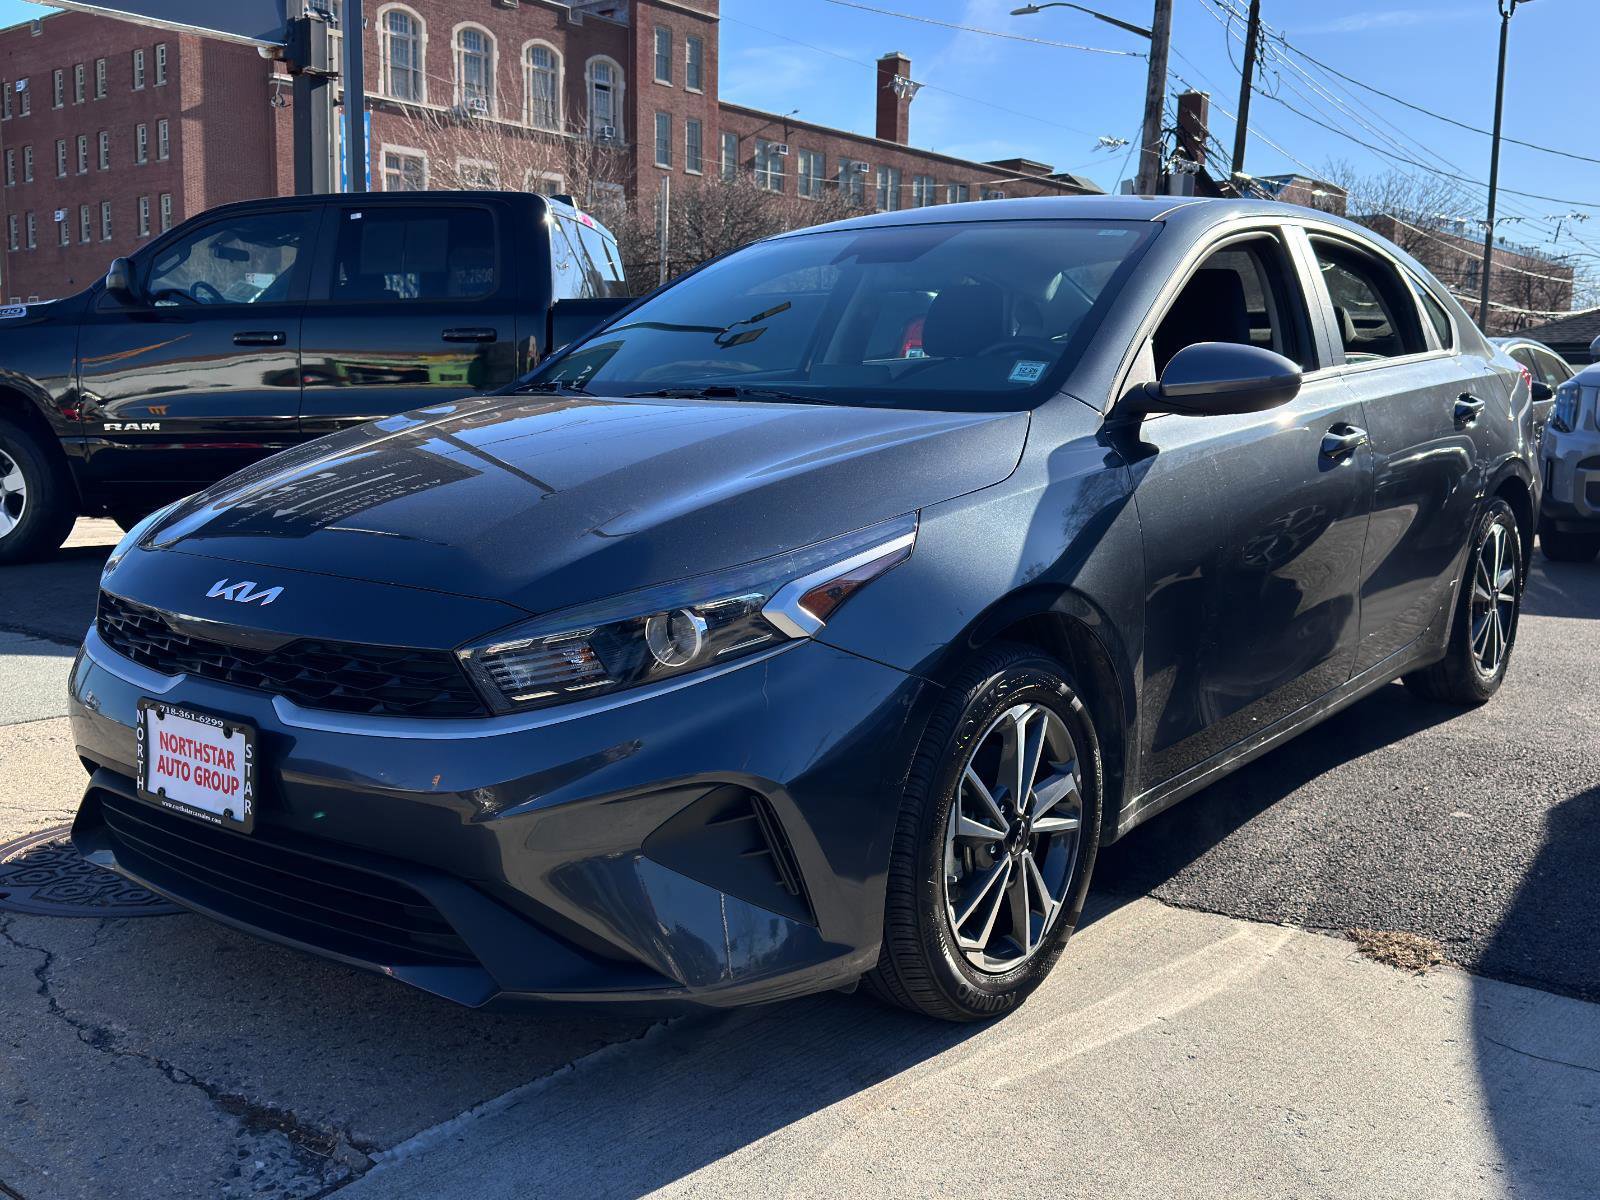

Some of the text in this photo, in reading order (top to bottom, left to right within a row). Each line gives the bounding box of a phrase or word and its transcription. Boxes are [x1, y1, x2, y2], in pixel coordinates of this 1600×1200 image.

[103, 422, 161, 431] RAM
[205, 578, 285, 606] KIA
[159, 704, 224, 728] 718-361-6299
[136, 709, 144, 790] NORTH
[159, 730, 236, 772] NORTHSTAR
[157, 754, 240, 796] AUTO GROUP
[244, 743, 253, 815] STAR
[956, 983, 1017, 1011] KUMHO
